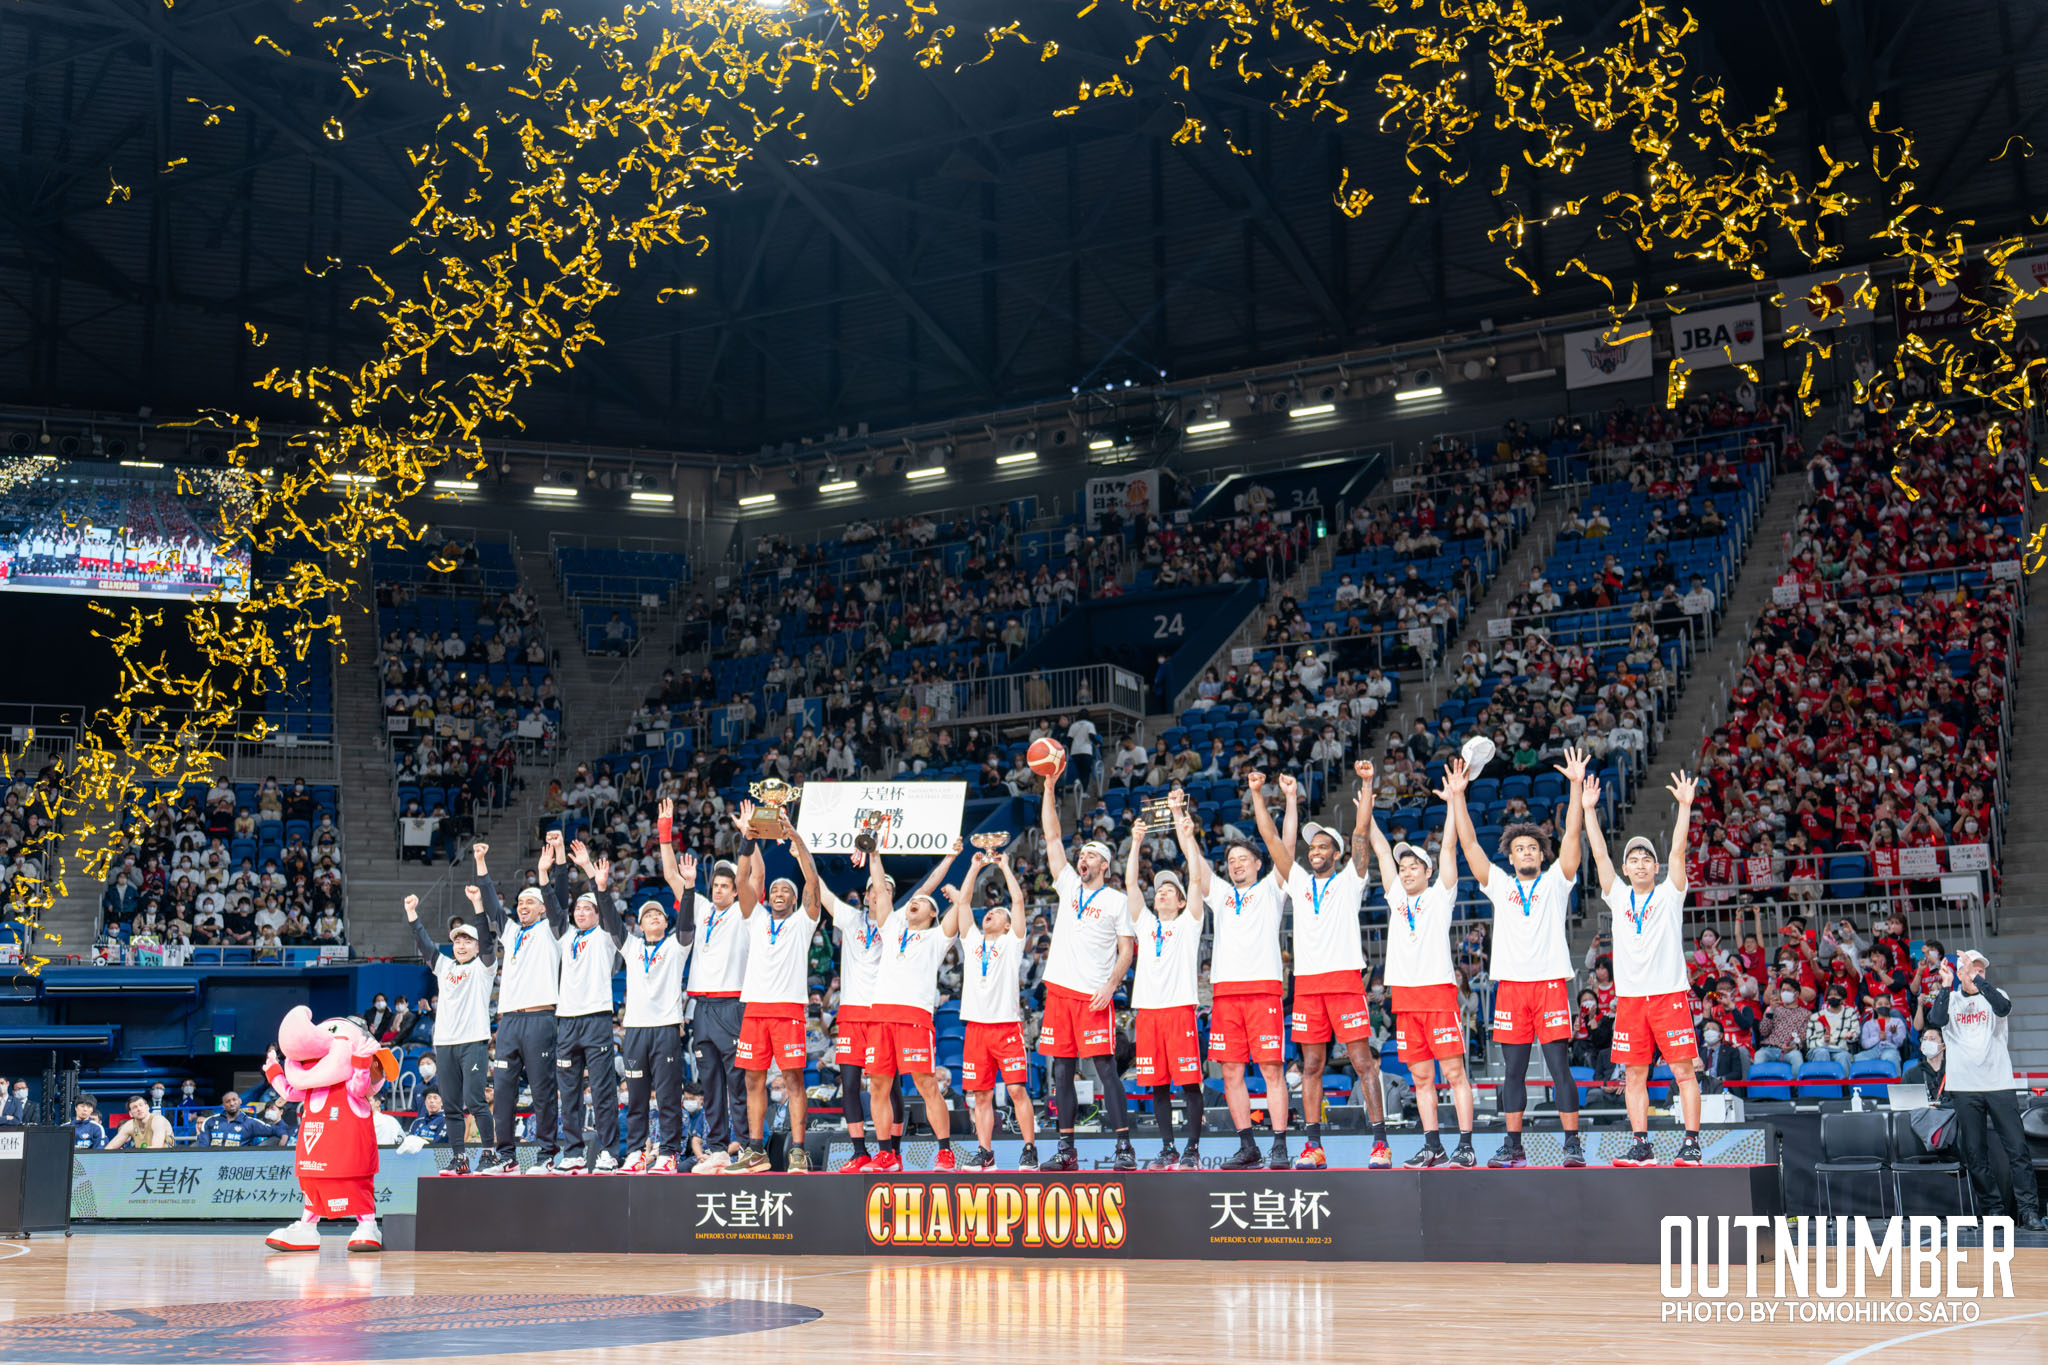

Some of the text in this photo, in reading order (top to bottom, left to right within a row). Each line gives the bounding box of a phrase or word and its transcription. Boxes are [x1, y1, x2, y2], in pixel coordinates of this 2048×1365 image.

[2031, 262, 2048, 274] CHI
[1680, 324, 1732, 352] JBA
[1291, 487, 1320, 507] 34
[98, 581, 140, 591] CHAMPIONS
[1153, 612, 1185, 639] 24
[802, 707, 815, 727] K
[860, 786, 905, 801] 天皇杯
[1956, 1010, 1987, 1025] CHAMPS
[131, 1166, 203, 1195] 天皇杯
[216, 1165, 294, 1182] 第98回天皇杯
[695, 1189, 794, 1228] 天皇杯
[866, 1182, 1127, 1249] CHAMPIONS
[1209, 1188, 1332, 1230] 天皇杯
[695, 1232, 794, 1240] EMPEROR'S CUP BASKETBALL 2022-23
[1209, 1235, 1333, 1244] EMPEROR'S CUP BASKETBALL 2022-23
